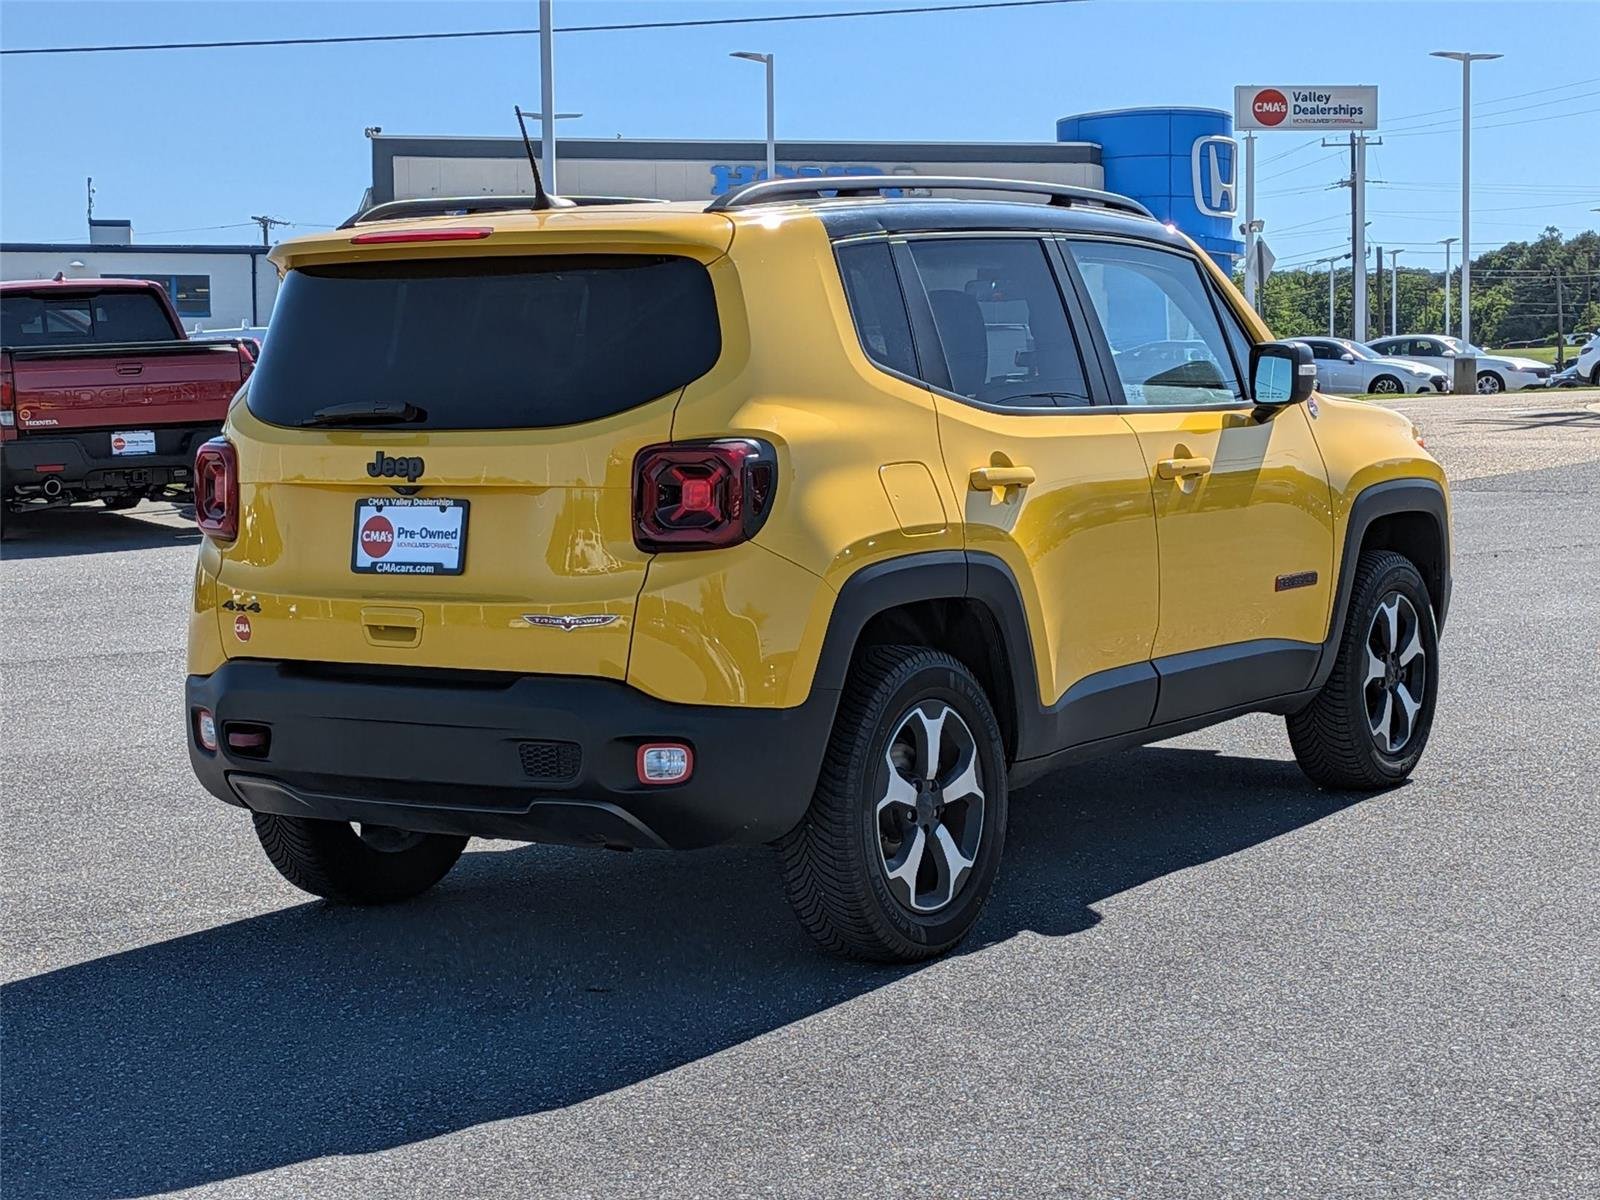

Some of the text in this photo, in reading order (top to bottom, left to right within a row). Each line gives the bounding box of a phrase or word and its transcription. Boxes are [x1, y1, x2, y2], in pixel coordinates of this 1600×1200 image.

[1292, 91, 1332, 104] Valley
[1254, 102, 1287, 113] CMA's
[1293, 104, 1364, 117] Dealerships
[366, 451, 425, 482] Jeep
[367, 498, 454, 507] CMA's Valley Dealerships
[362, 530, 393, 542] CMA's
[397, 526, 458, 540] Pre-Owned
[375, 562, 435, 574] CMAcars.com
[221, 600, 262, 613] 4x4
